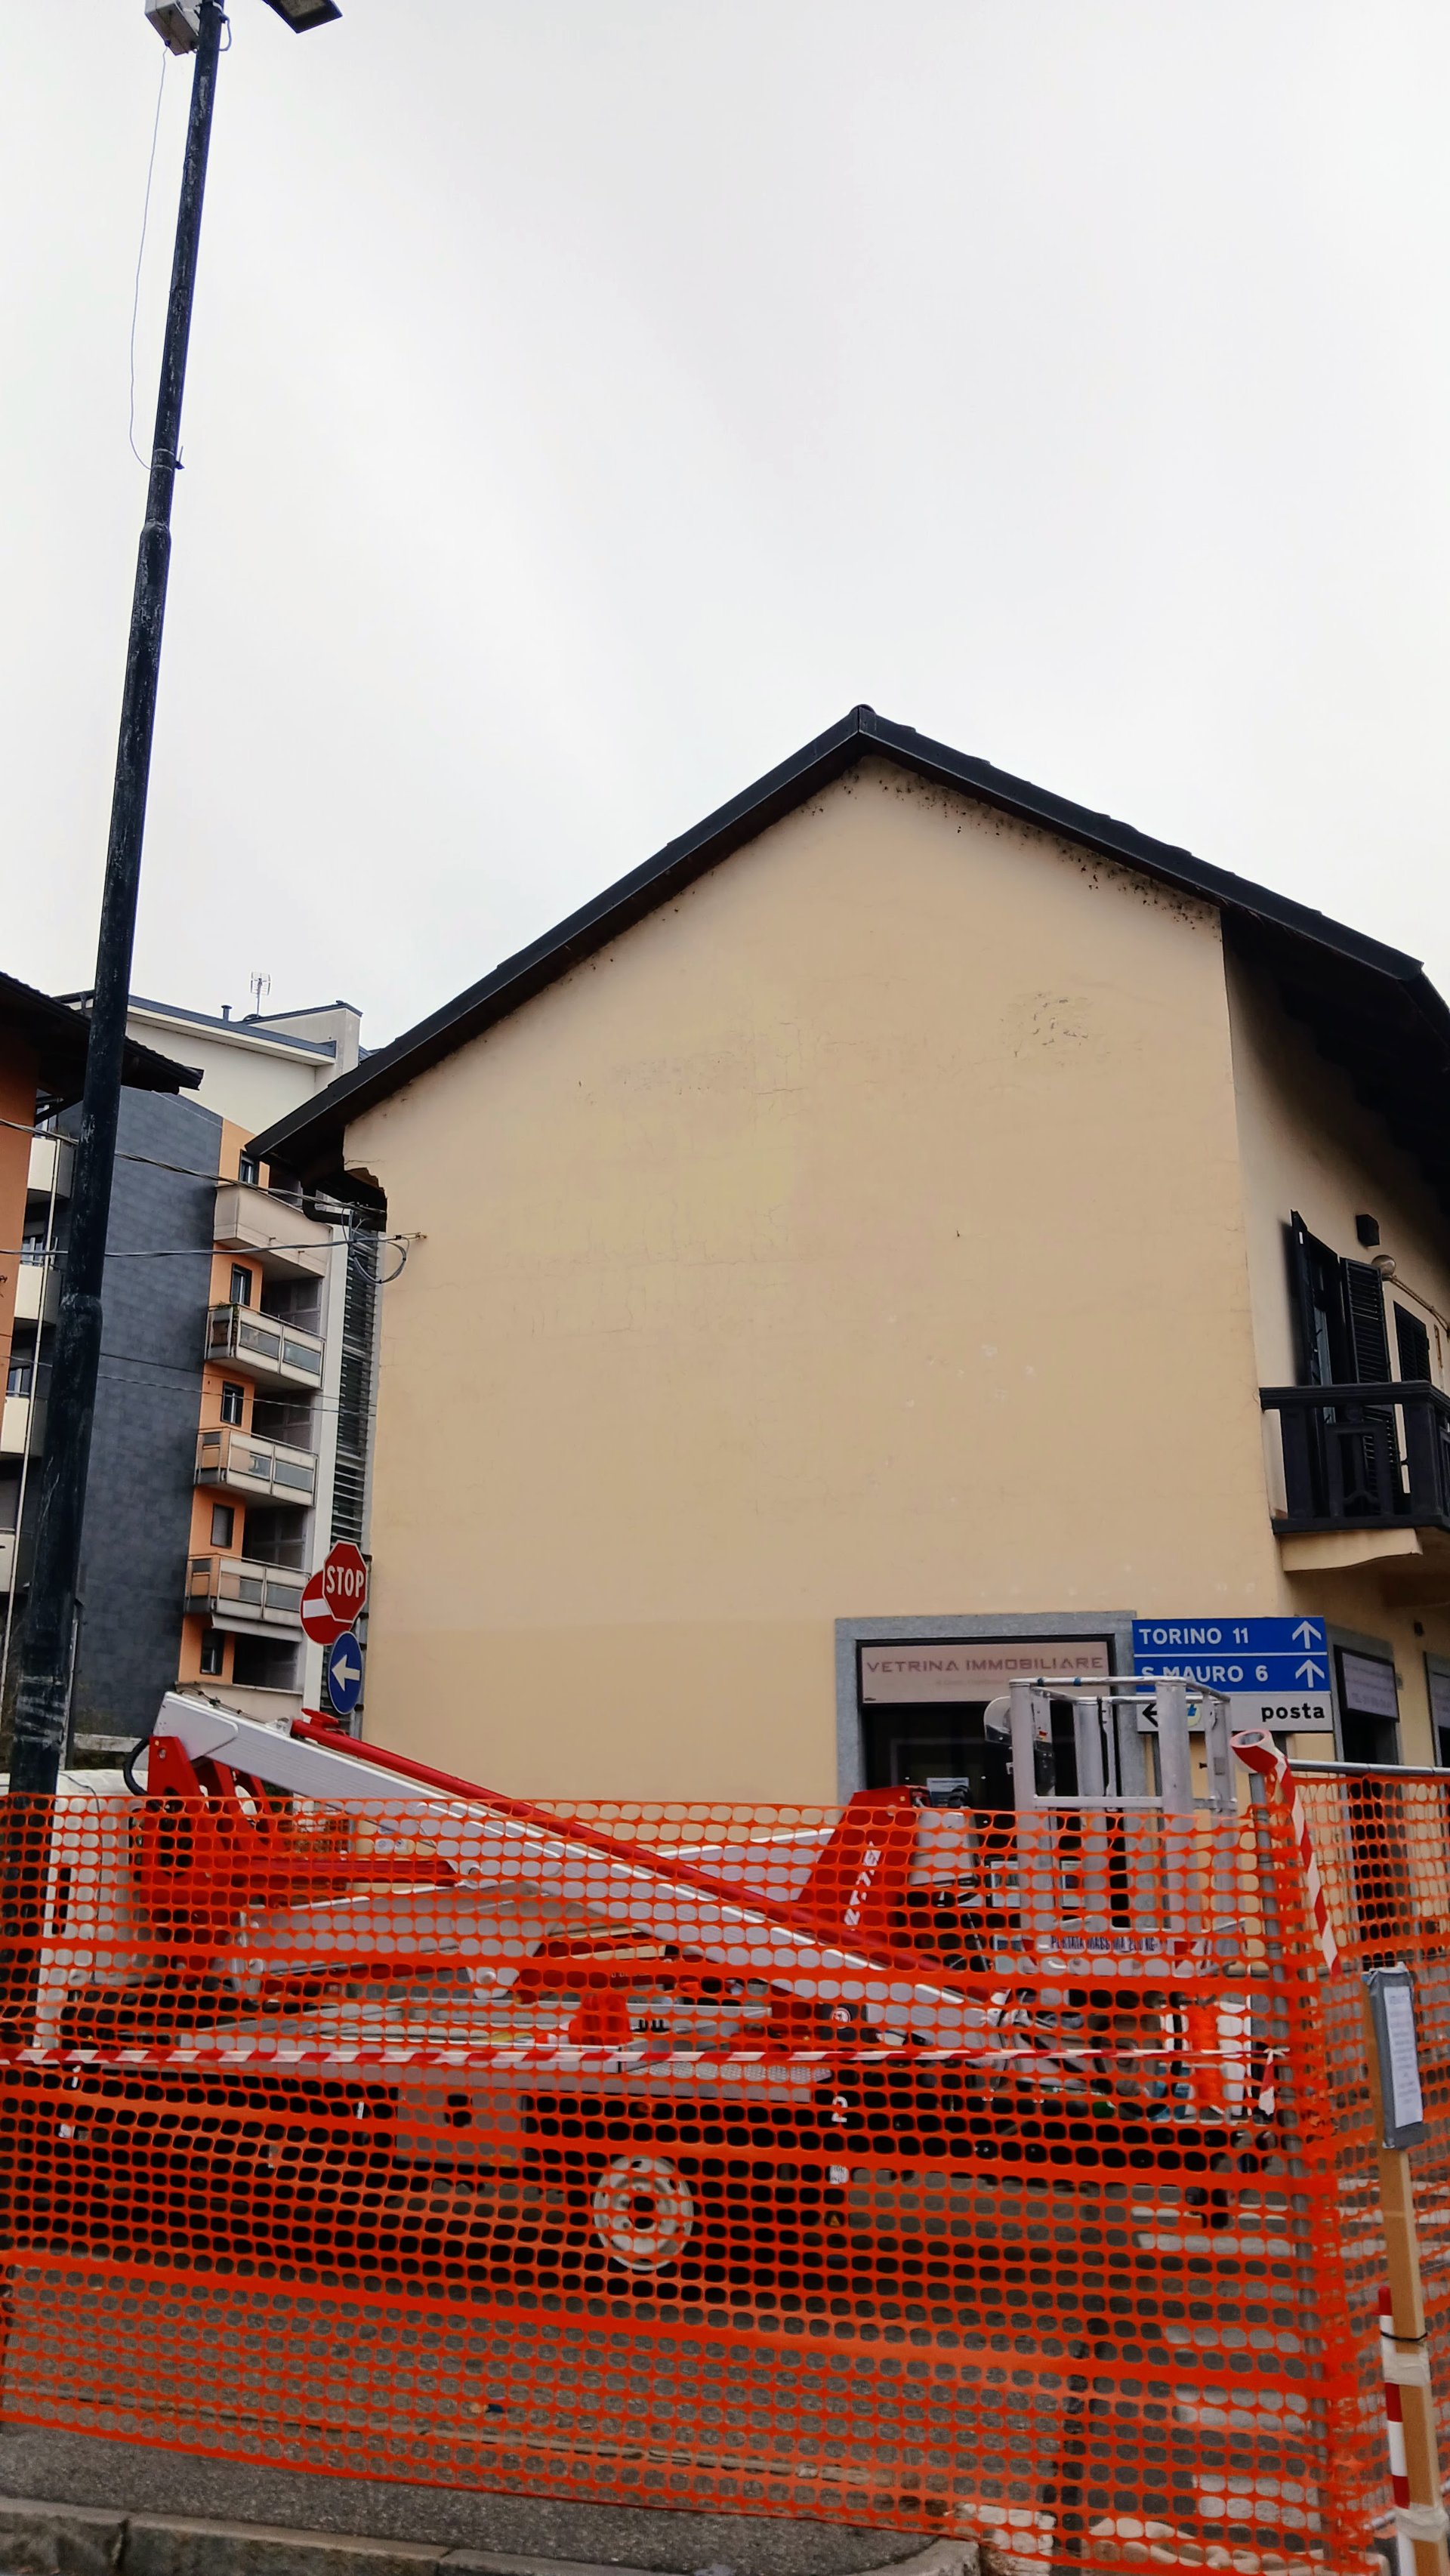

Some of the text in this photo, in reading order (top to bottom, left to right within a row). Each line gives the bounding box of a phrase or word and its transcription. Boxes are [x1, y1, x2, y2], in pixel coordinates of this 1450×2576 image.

[325, 1565, 365, 1598] STOP
[1138, 1627, 1249, 1645] TORINO 11
[866, 1657, 1104, 1674] VETRINA IMMOBILIARE
[1163, 1665, 1245, 1683] MAURO
[1254, 1664, 1269, 1683] 6
[1260, 1702, 1325, 1723] posta
